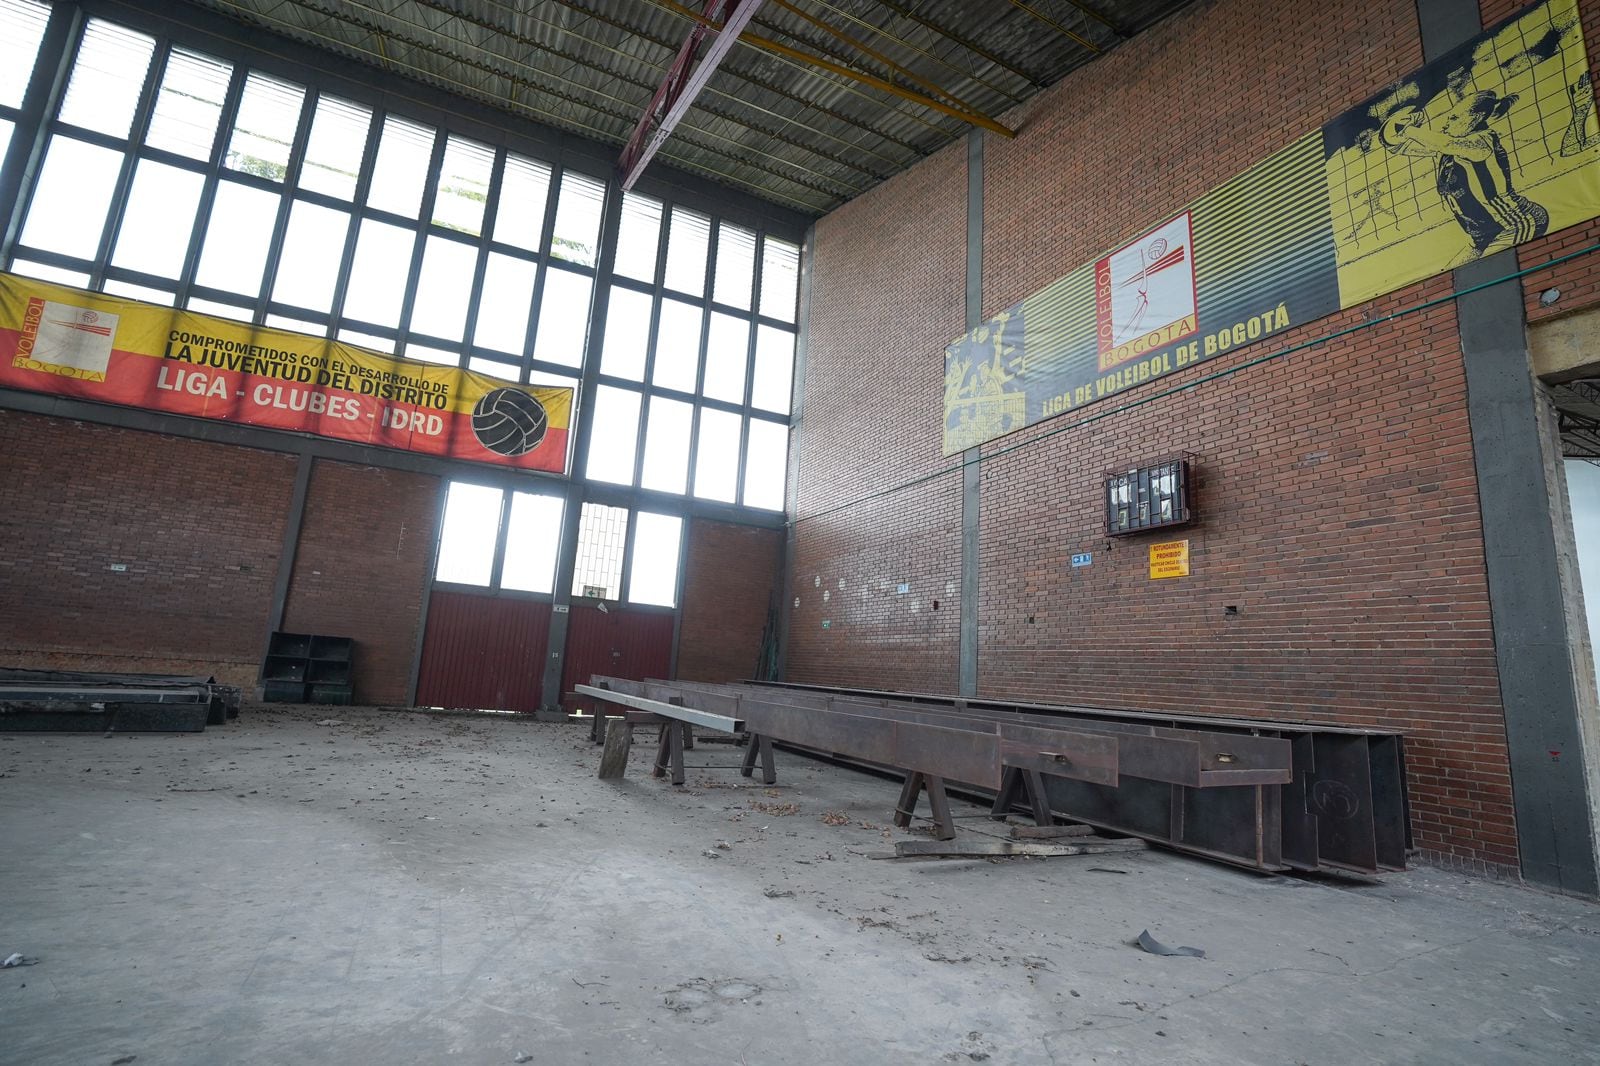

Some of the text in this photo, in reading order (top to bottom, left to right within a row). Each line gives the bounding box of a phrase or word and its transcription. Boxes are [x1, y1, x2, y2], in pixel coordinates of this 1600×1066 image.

[17, 300, 44, 357] VOLEIBOL
[1098, 260, 1113, 350] VOLEIBOL
[14, 358, 104, 382] BOGOTA
[164, 341, 448, 410] LA JUVENTUD DEL DISTRITO
[169, 330, 449, 395] COMPROMETIDOS CON EL DESARROLLO DE
[1042, 300, 1290, 417] LIGA DE VOLEIBOL DE BOGOTÁ
[1104, 319, 1191, 367] BOGOTA
[156, 366, 228, 400] LIGA
[253, 383, 361, 421] CLUBES
[381, 406, 444, 436] IDRD
